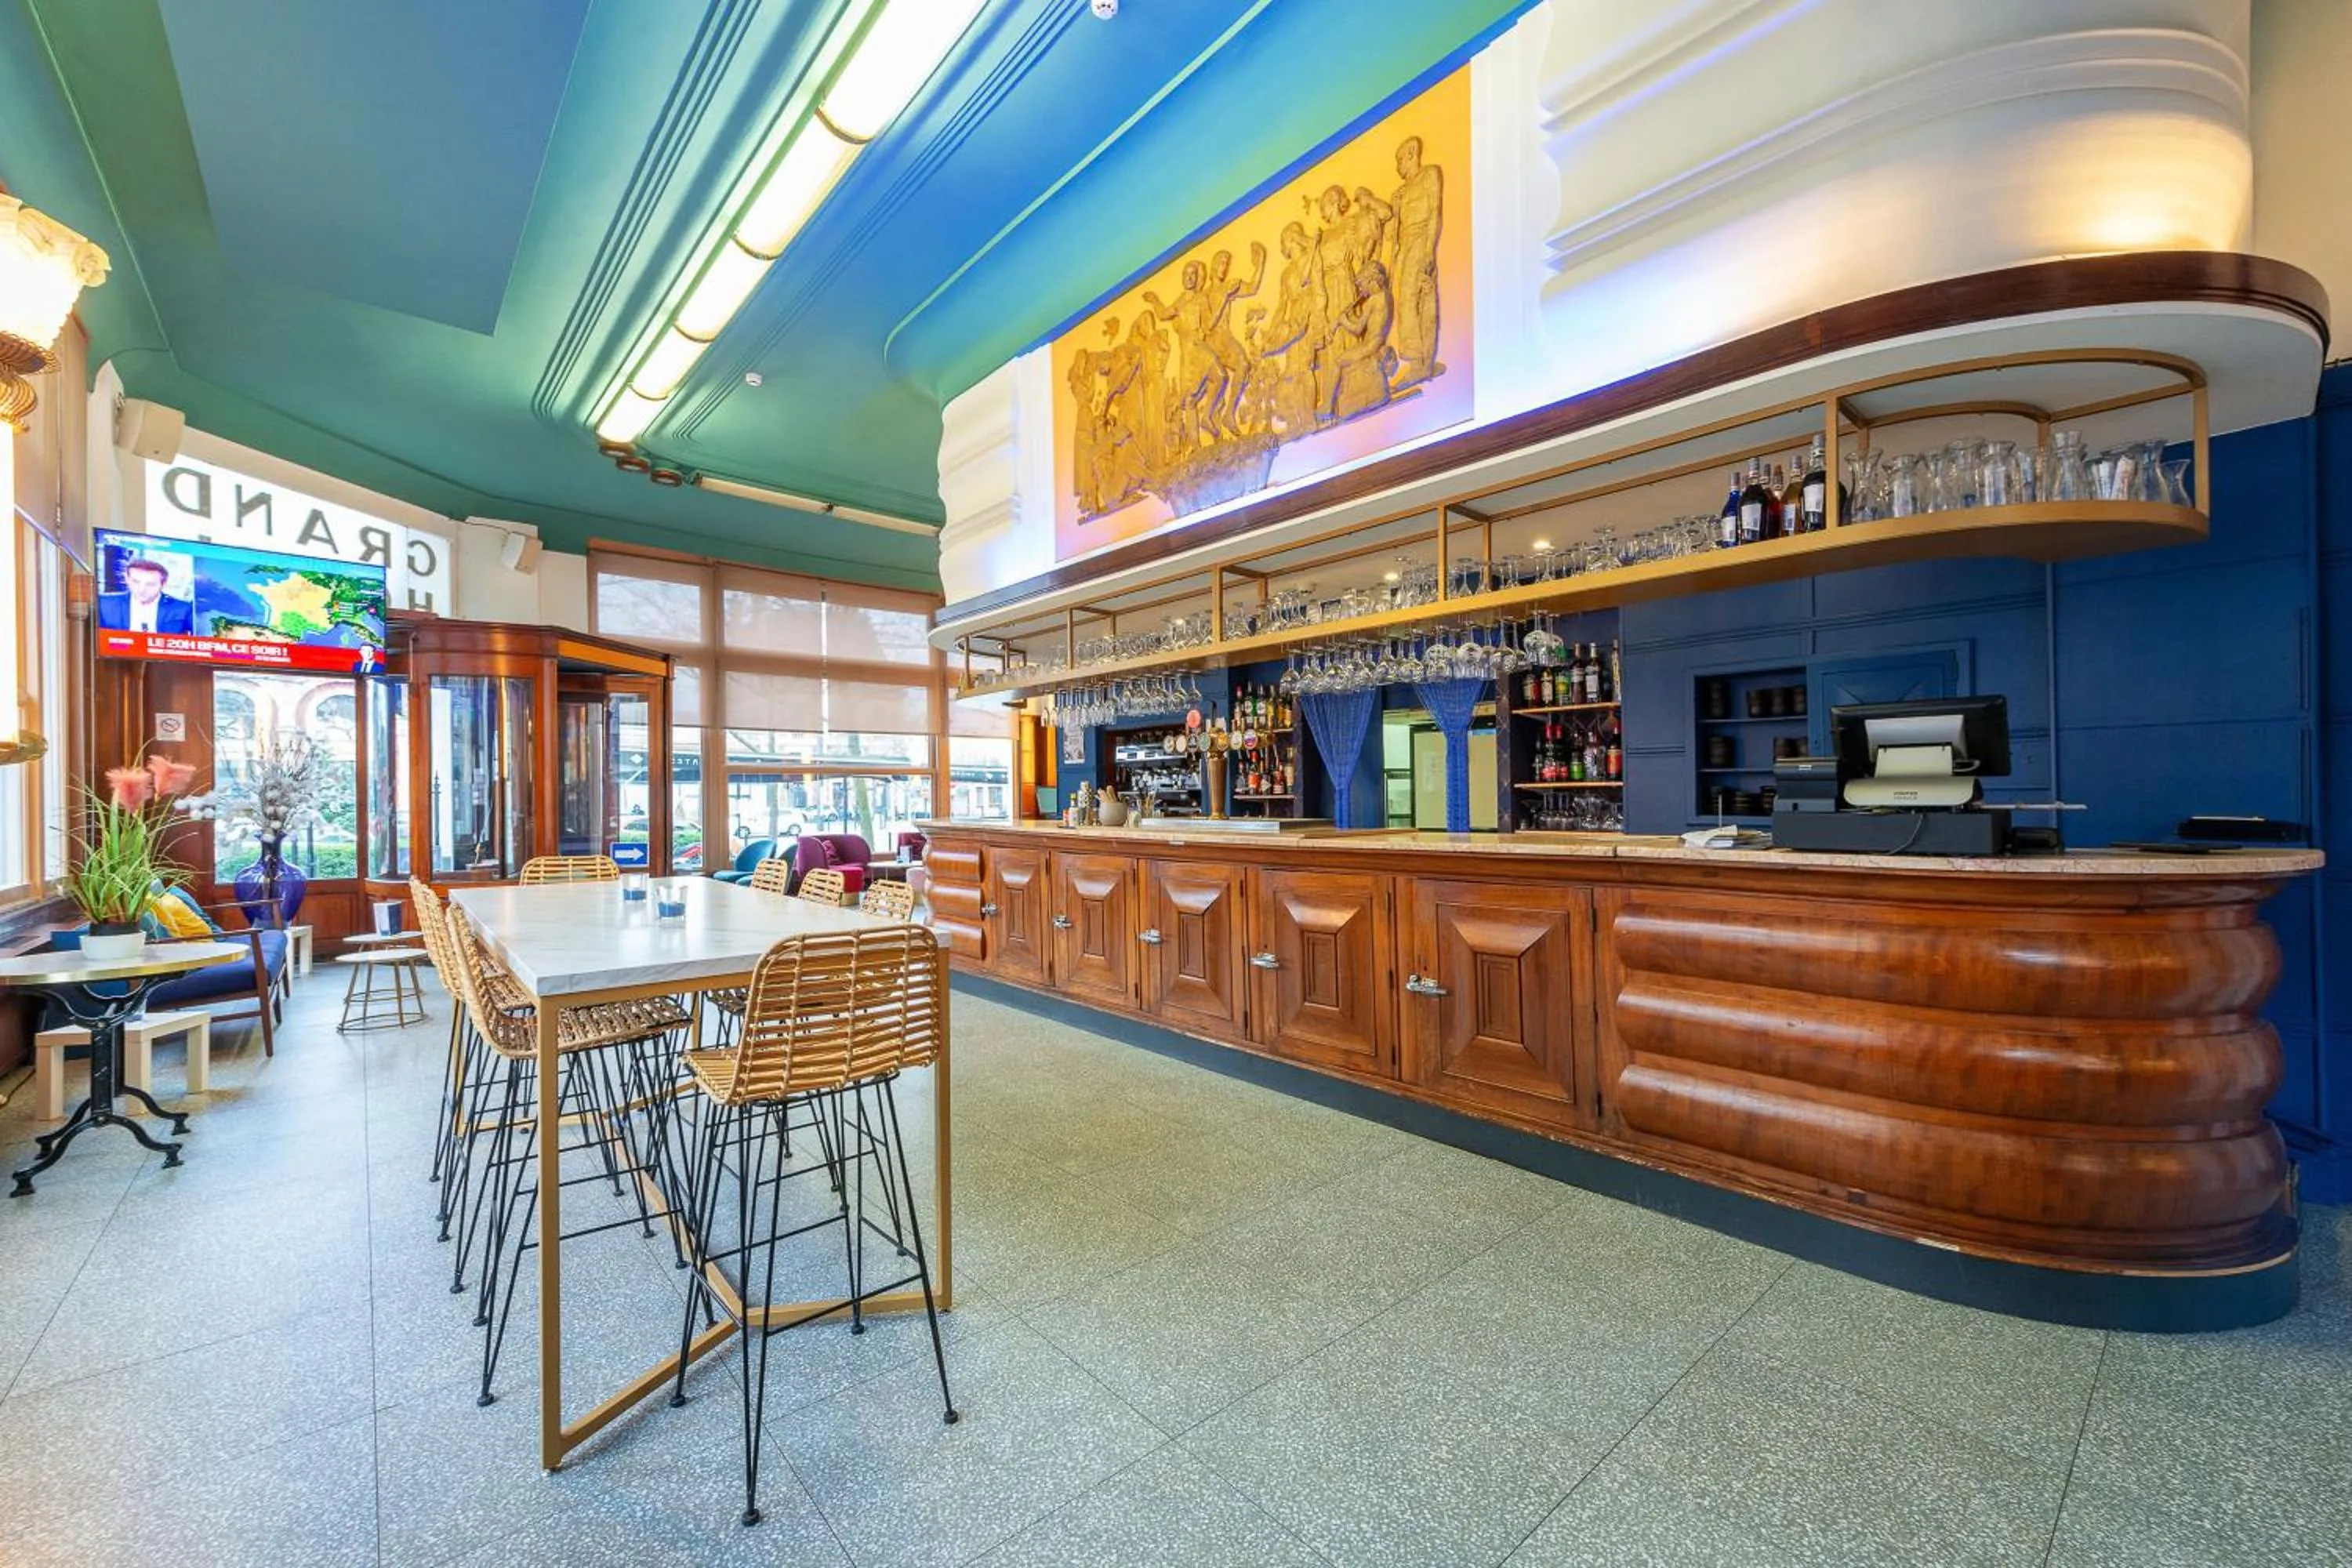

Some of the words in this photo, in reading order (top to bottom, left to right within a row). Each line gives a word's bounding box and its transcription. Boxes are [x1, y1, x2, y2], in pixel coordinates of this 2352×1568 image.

[147, 637, 165, 648] LE
[231, 644, 249, 654] CE
[250, 645, 282, 656] SOIR
